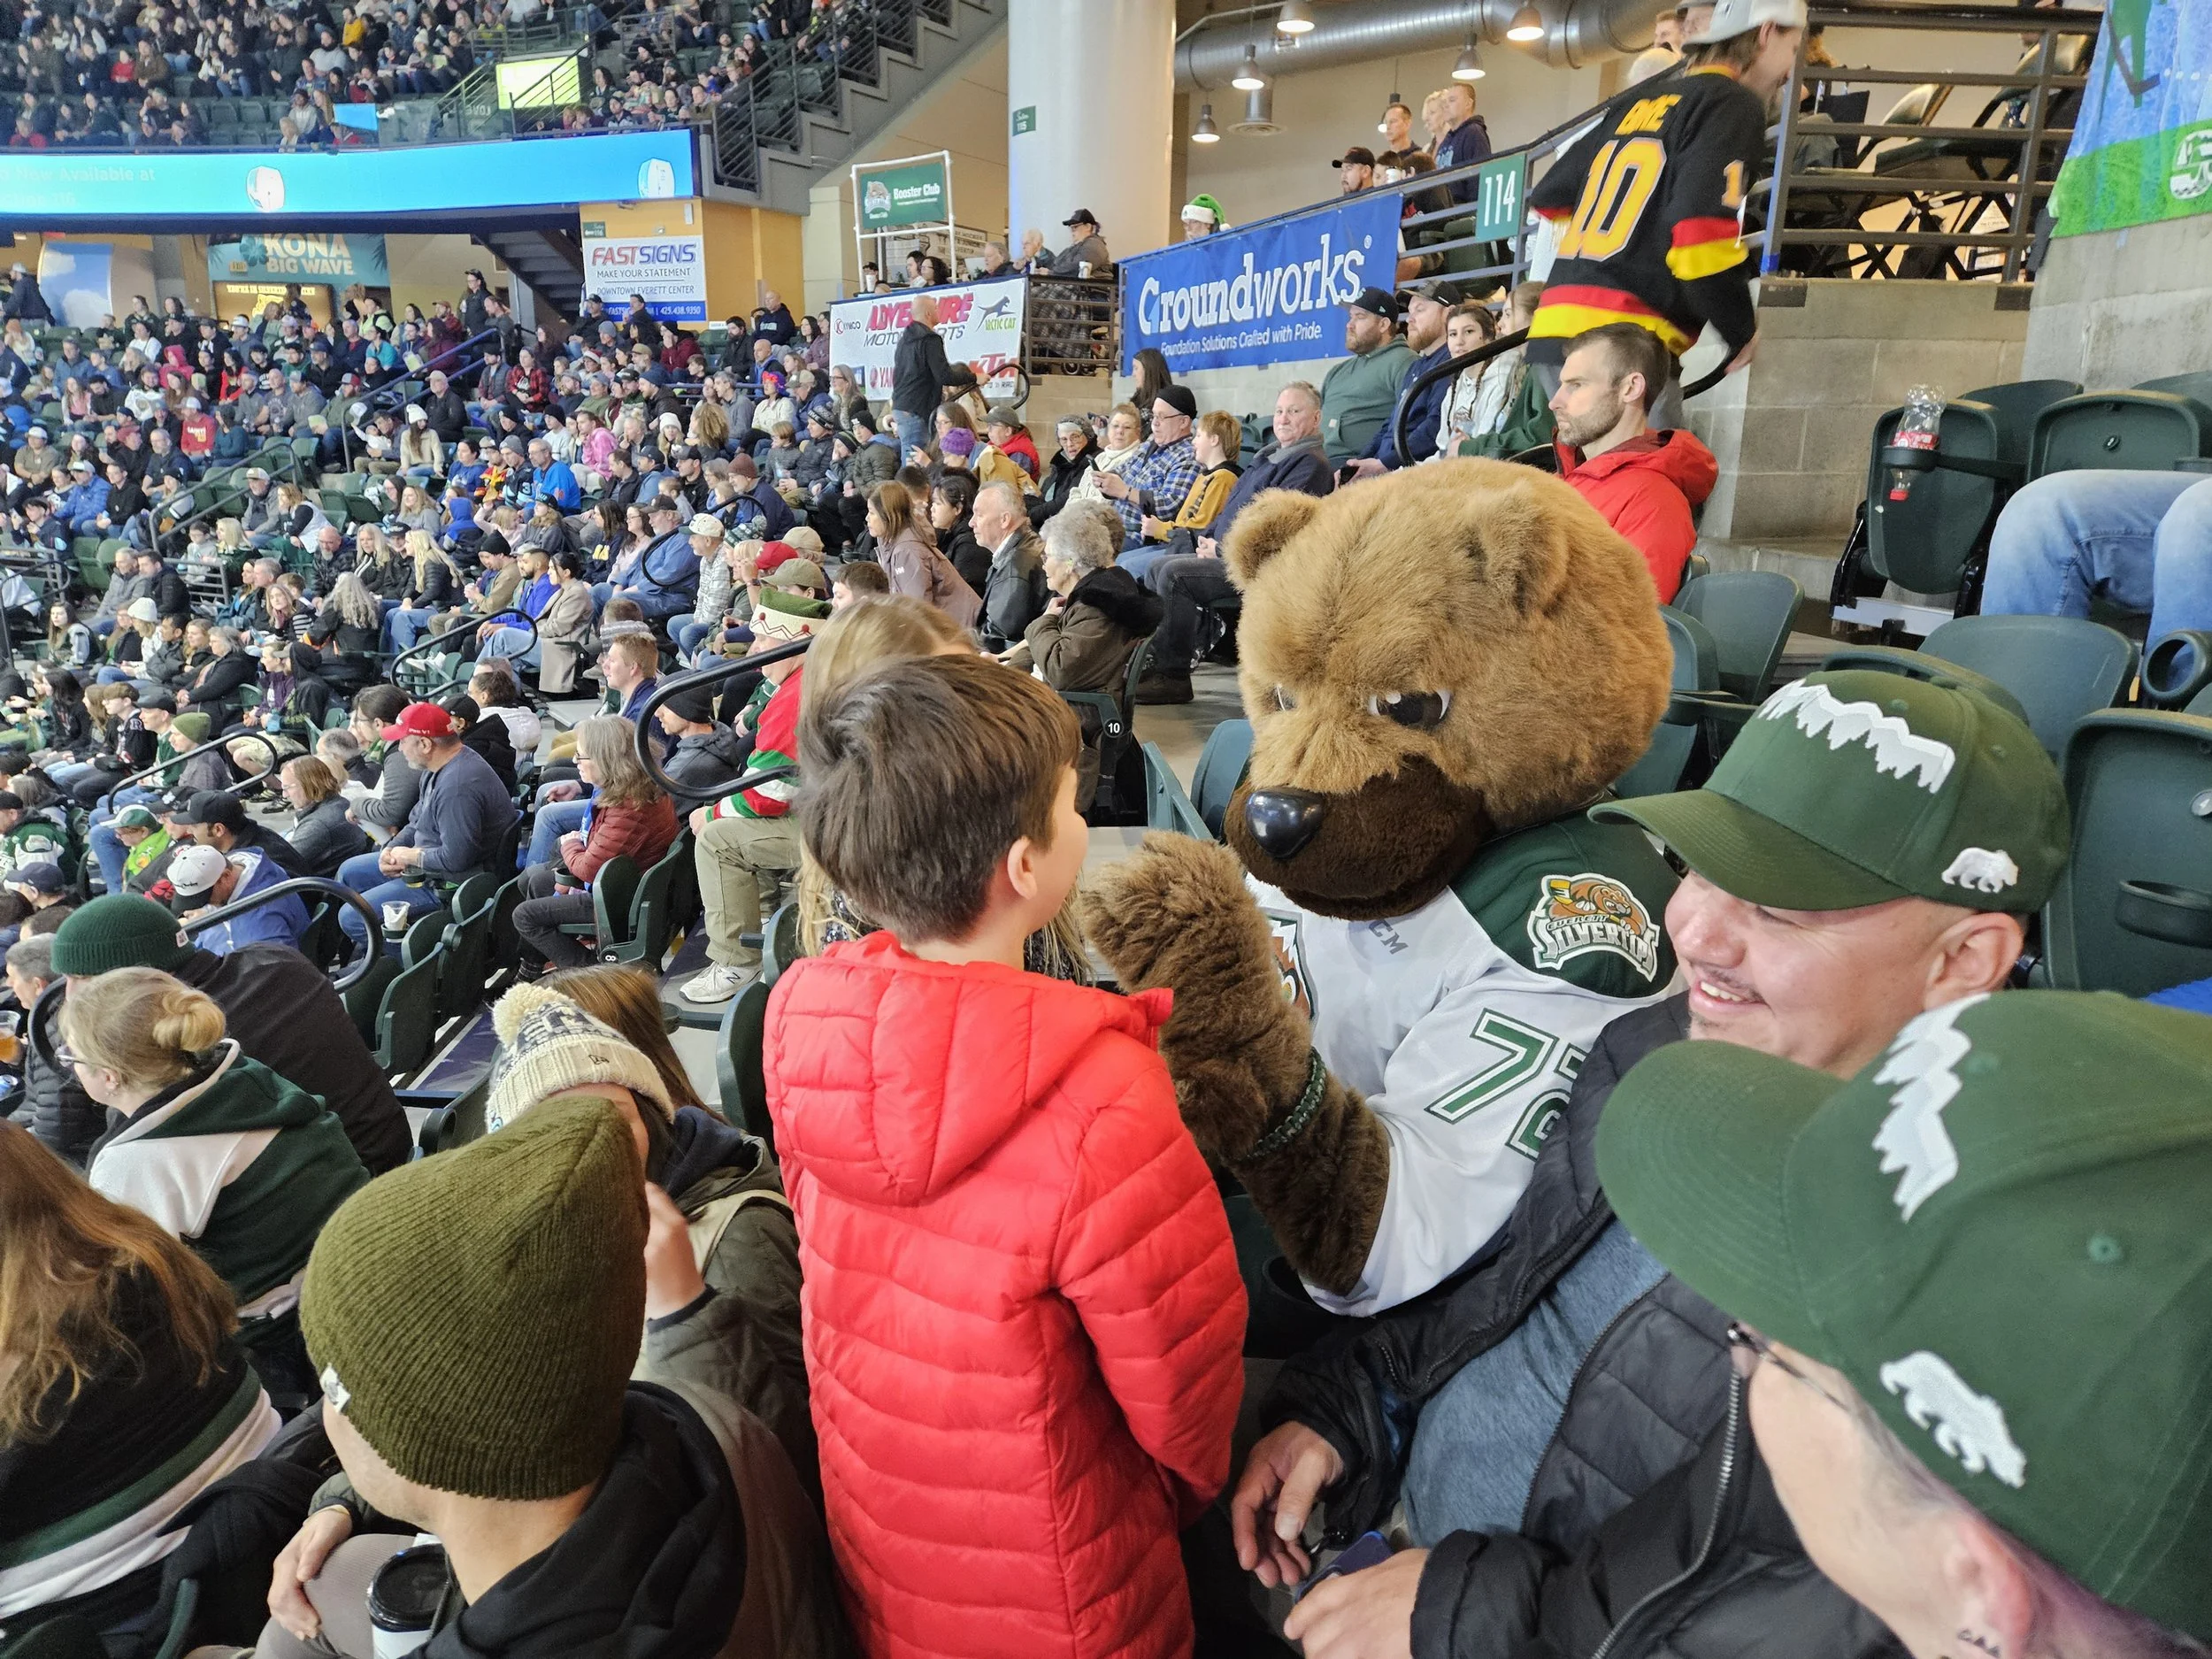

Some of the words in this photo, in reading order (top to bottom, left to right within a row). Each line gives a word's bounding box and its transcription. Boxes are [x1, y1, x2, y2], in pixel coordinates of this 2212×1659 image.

[59, 165, 134, 182] Available
[139, 167, 157, 182] at
[893, 187, 922, 200] Booster
[923, 182, 941, 196] Club
[1485, 171, 1516, 227] 114
[1556, 137, 1667, 262] 10
[265, 234, 350, 258] KONA
[591, 244, 696, 265] FASTSIGNS
[267, 258, 299, 273] BIG
[301, 258, 354, 275] WAVE
[644, 267, 690, 277] STATEMENT
[596, 287, 635, 296] DOWNTOWN
[668, 286, 695, 295] CENTER
[1138, 233, 1365, 335] Groundworks
[1004, 317, 1016, 330] CAT
[1161, 338, 1201, 356] Foundation
[1202, 334, 1237, 352] Solutions
[1239, 330, 1269, 346] Crafted
[1271, 327, 1293, 343] with
[1294, 322, 1322, 341] Pride.
[1108, 722, 1120, 733] 10
[1548, 914, 1610, 931] EVERETT
[1536, 917, 1655, 971] SILVERTIPS
